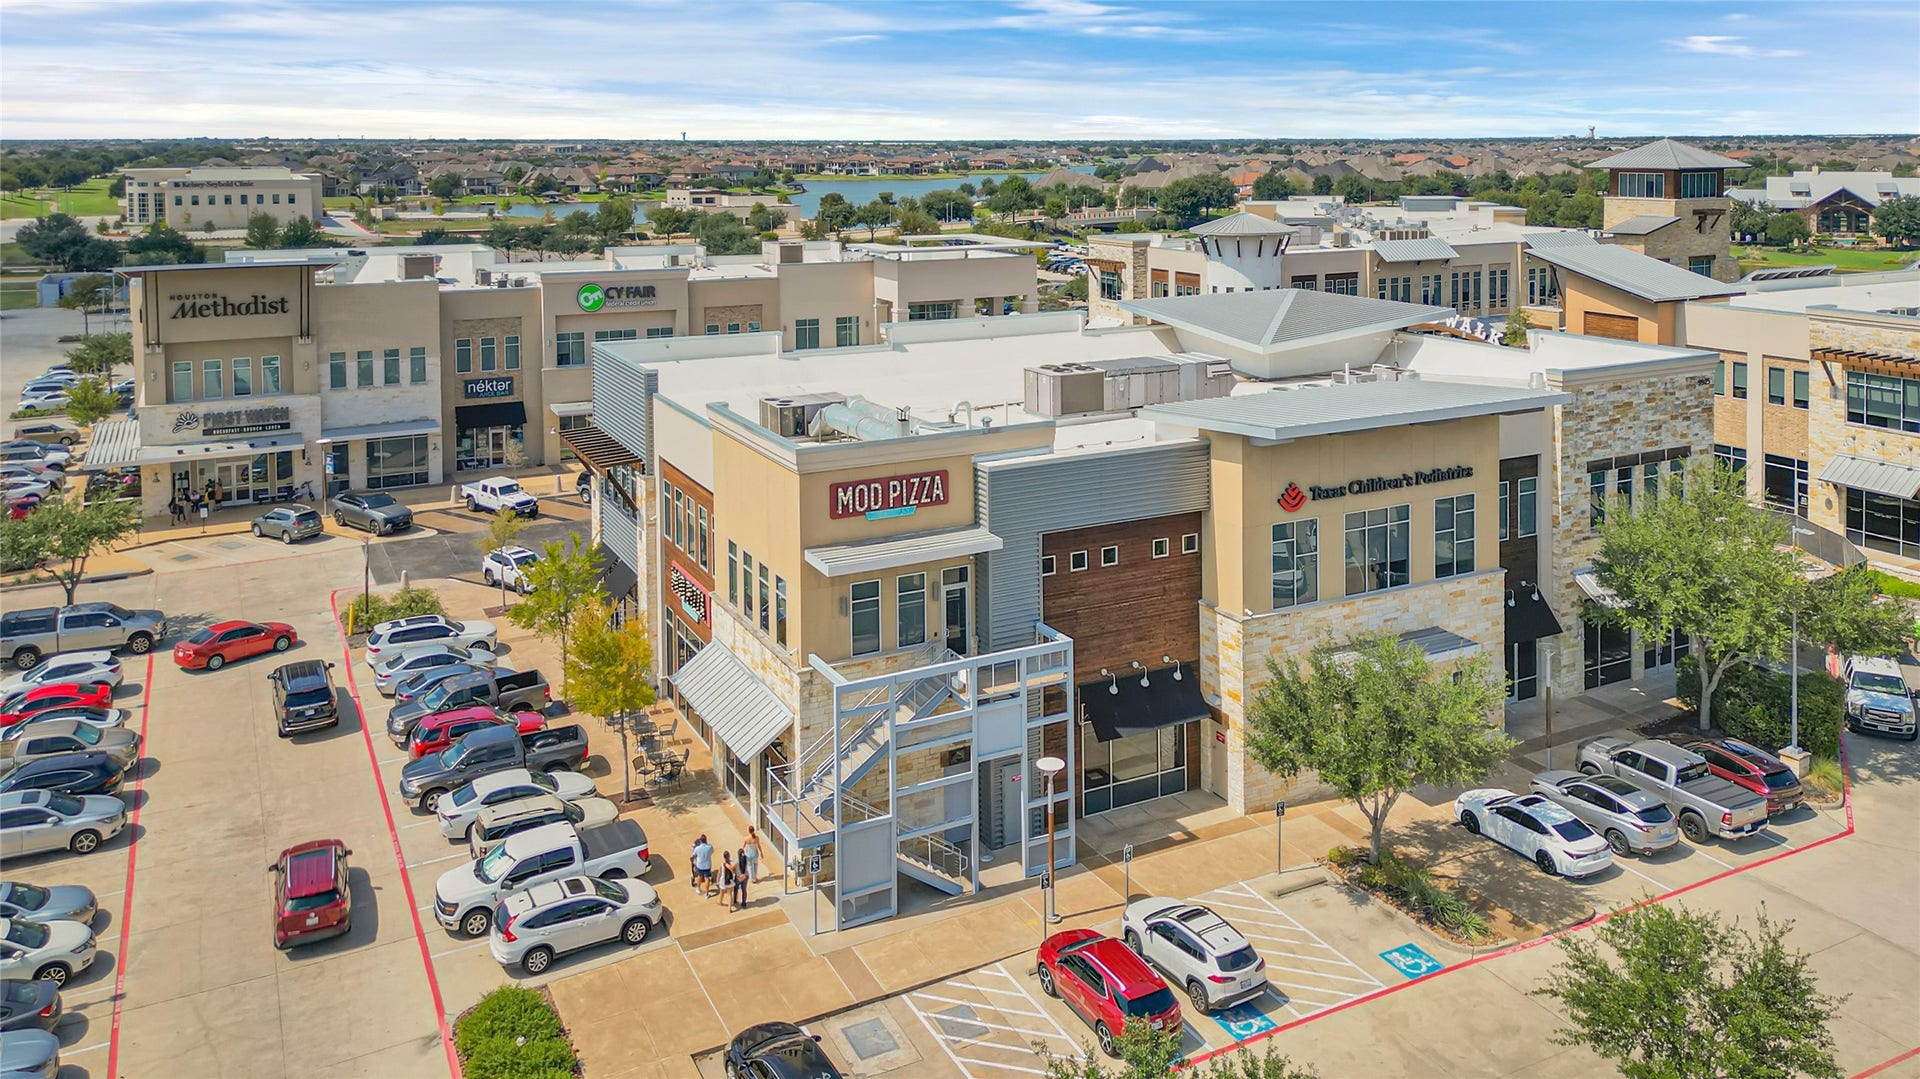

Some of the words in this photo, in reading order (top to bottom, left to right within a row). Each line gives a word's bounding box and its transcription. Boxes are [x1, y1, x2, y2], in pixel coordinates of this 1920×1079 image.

[169, 293, 218, 301] HOUSTON
[626, 285, 656, 298] FAIR
[170, 294, 289, 320] Methodist
[203, 410, 242, 428] FIRST
[1309, 485, 1347, 501] Texas
[1348, 473, 1413, 495] Children's
[1414, 465, 1474, 486] Pediatrics
[837, 482, 883, 515] MOD
[889, 475, 945, 508] PIZZA
